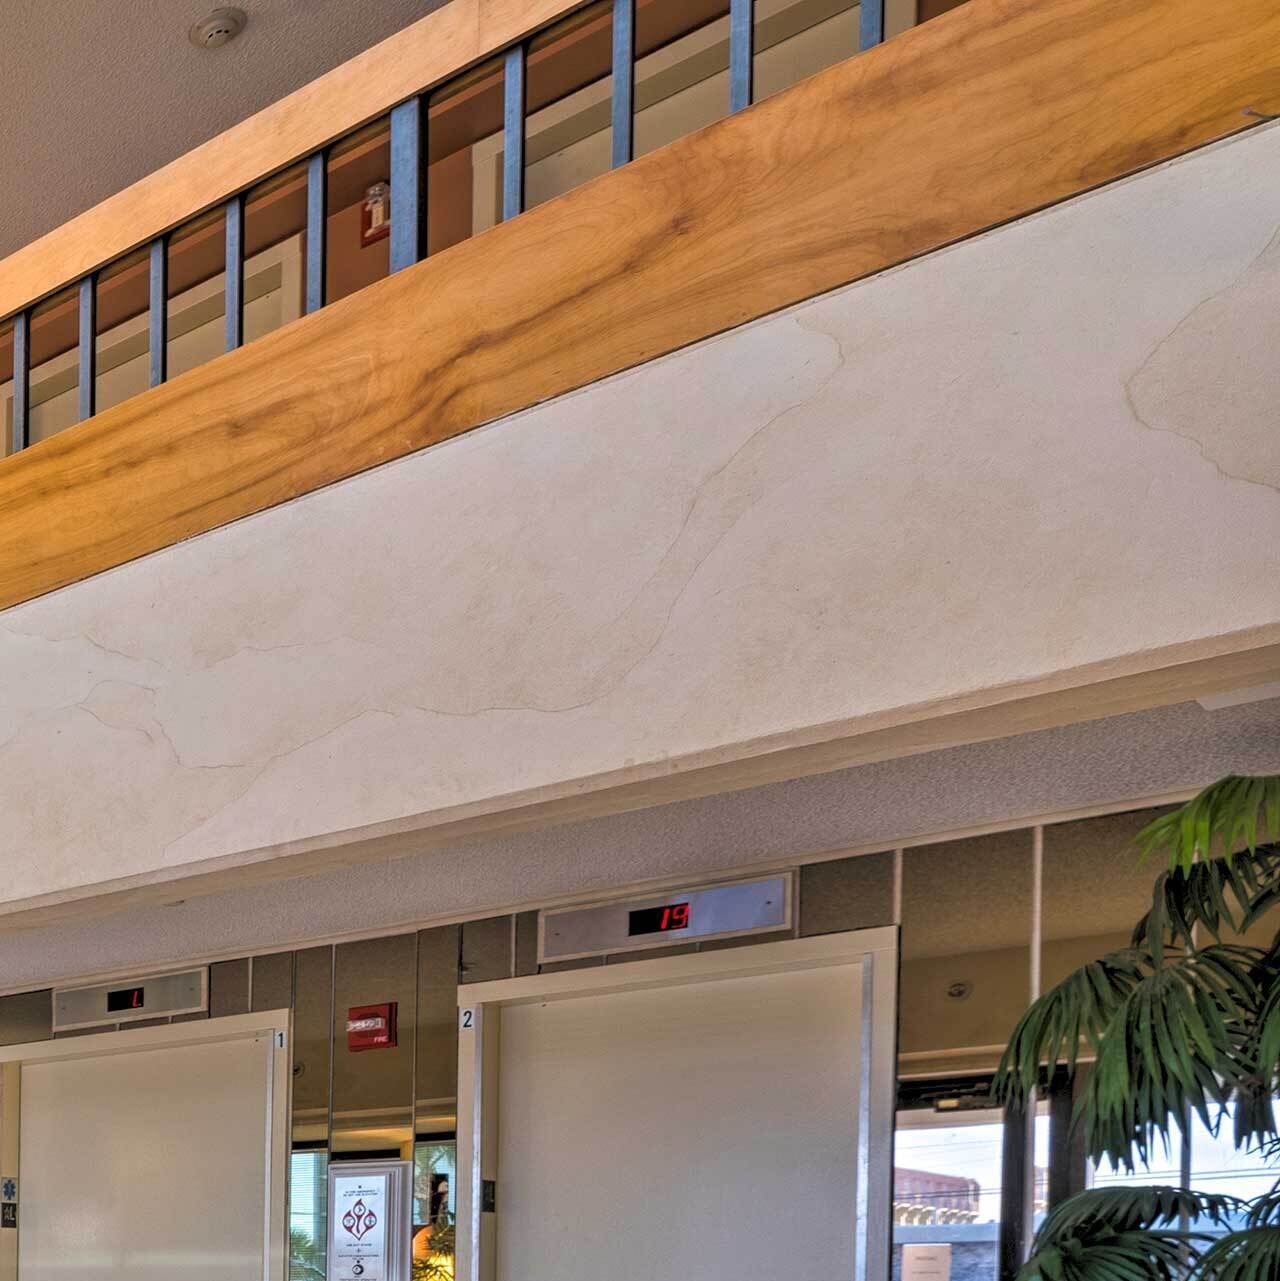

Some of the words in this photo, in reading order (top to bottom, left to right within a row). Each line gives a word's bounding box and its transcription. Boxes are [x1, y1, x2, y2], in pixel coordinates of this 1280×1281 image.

[660, 905, 689, 929] 19
[463, 1010, 472, 1028] 2
[278, 1032, 284, 1048] 1
